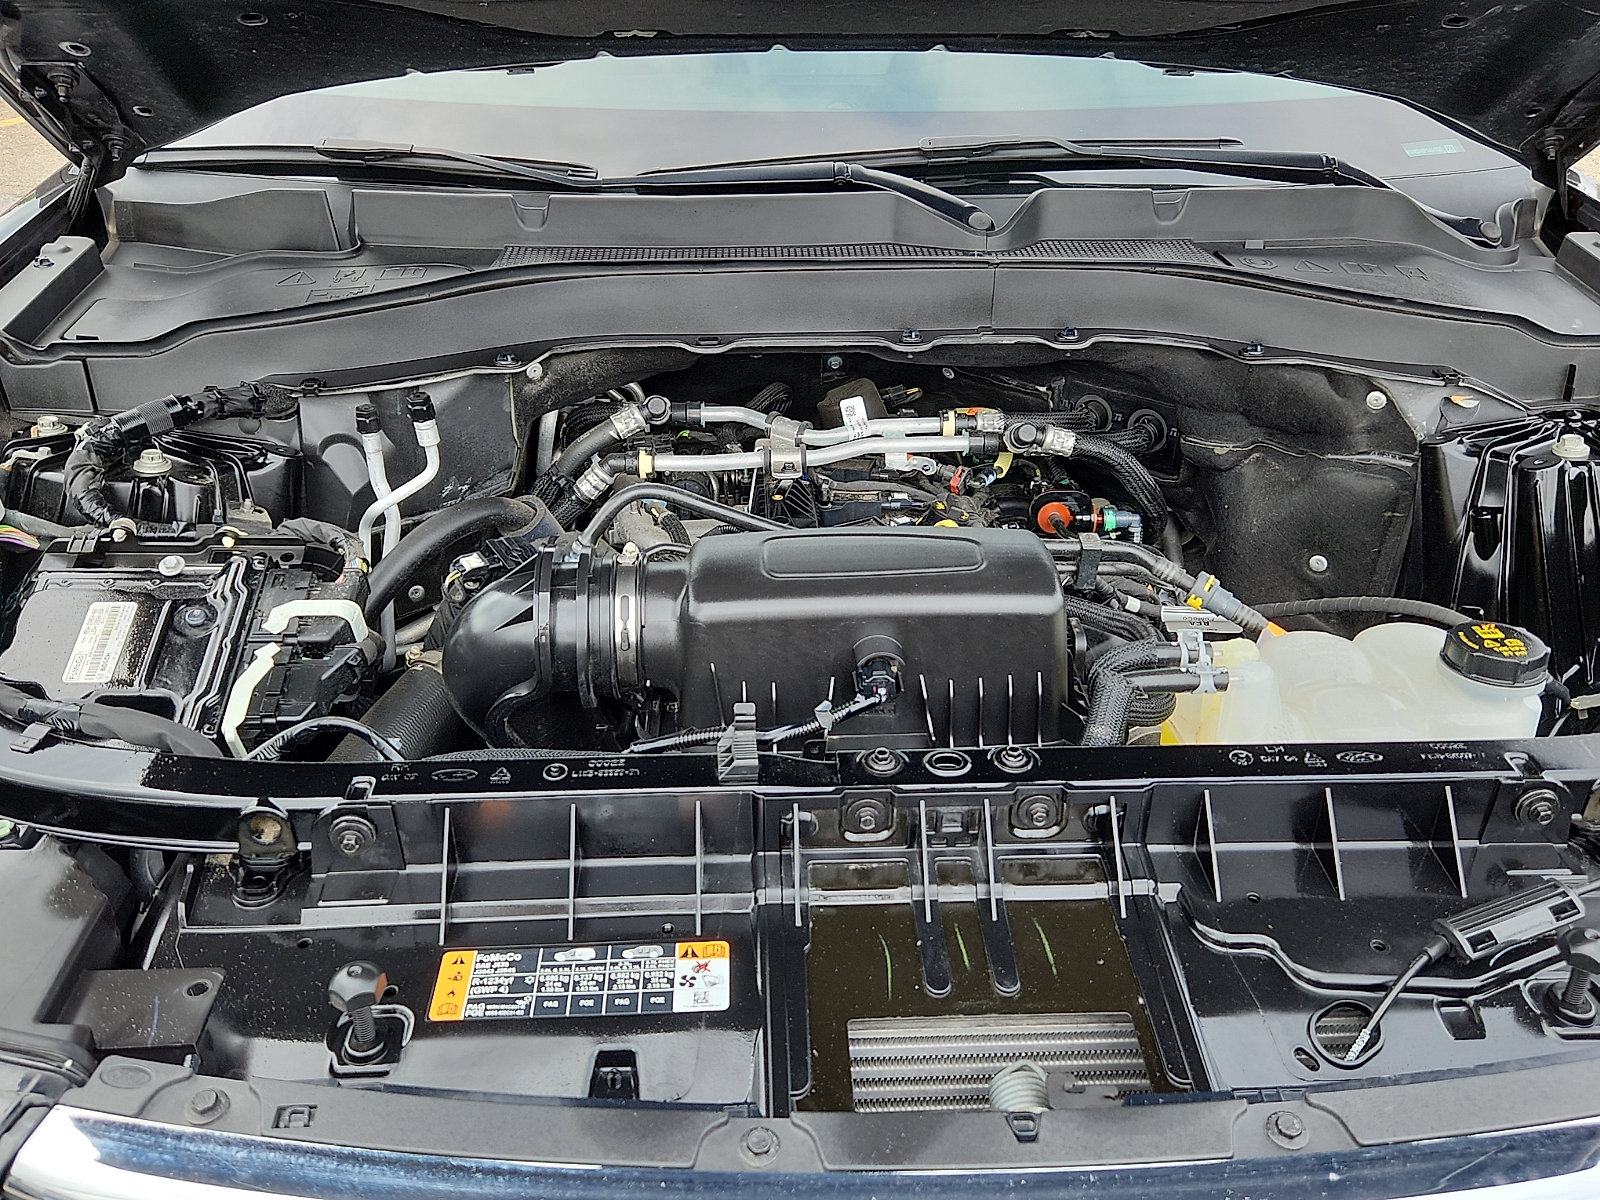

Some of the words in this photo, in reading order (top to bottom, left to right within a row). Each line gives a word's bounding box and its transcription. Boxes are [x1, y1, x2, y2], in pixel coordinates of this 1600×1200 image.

[476, 953, 522, 962] FoMoCo
[559, 975, 569, 983] kg
[593, 973, 603, 982] kg
[631, 972, 640, 980] kg
[664, 971, 674, 979] kg
[472, 976, 514, 986] R-1234yf
[470, 986, 498, 995] (GWP
[498, 986, 509, 994] 4)
[543, 1000, 559, 1008] PAG
